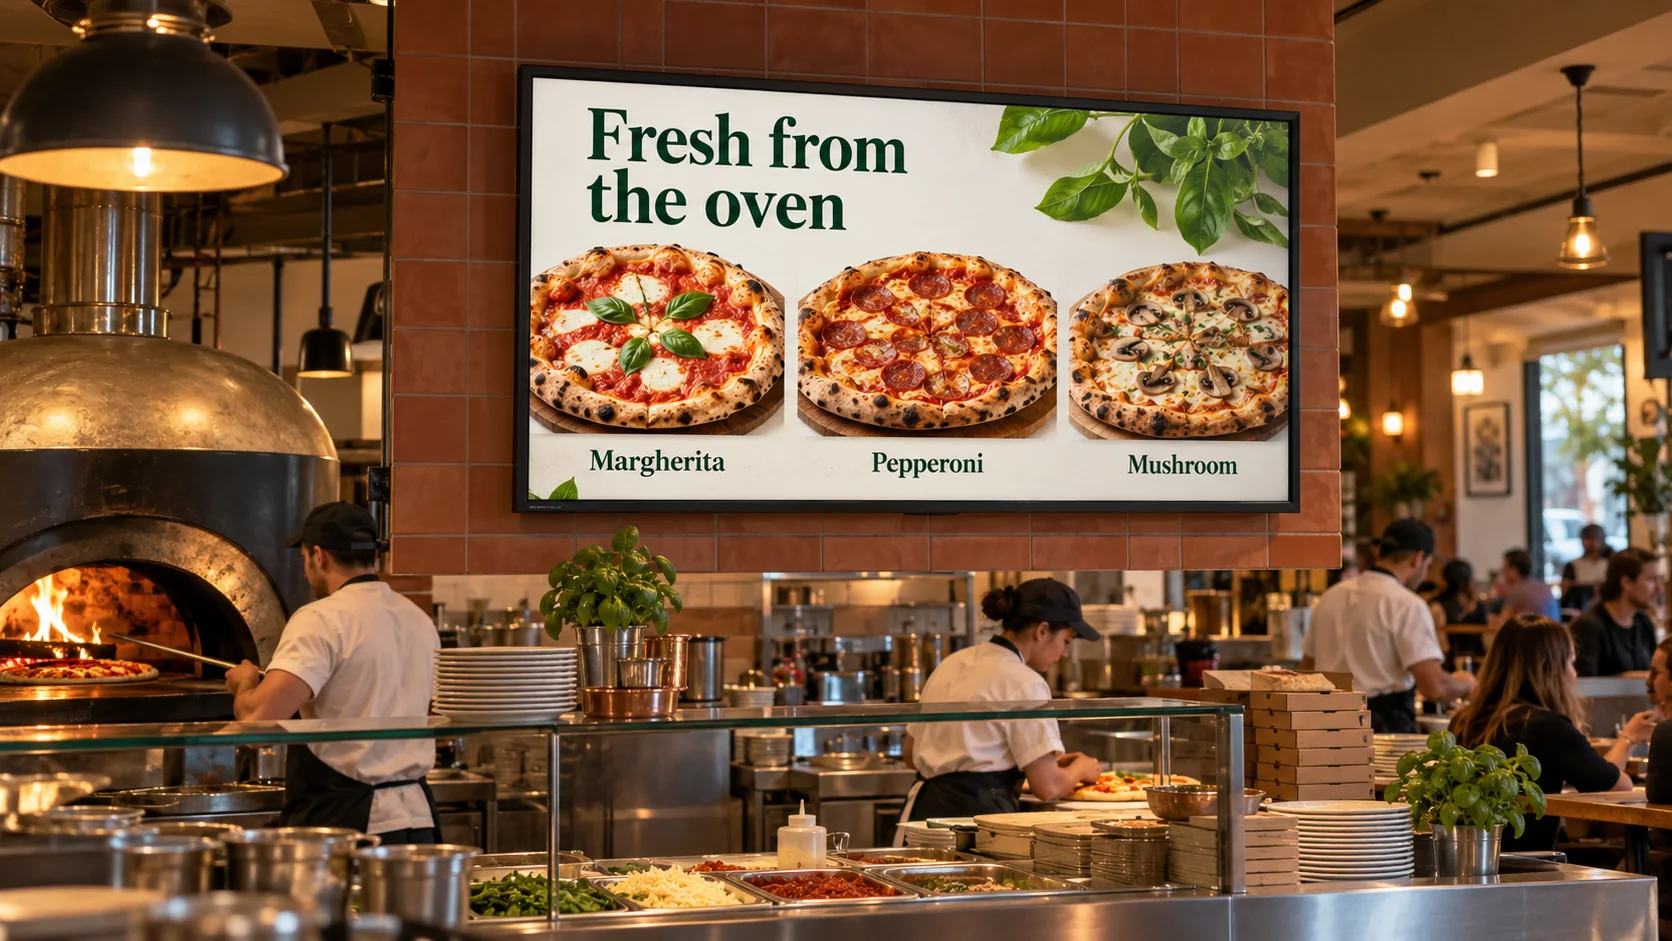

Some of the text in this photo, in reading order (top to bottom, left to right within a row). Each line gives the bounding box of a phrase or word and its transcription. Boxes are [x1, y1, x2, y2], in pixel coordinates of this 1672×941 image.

[588, 107, 908, 174] Fresh from
[587, 167, 847, 231] the oven
[589, 449, 726, 478] Margherita
[872, 451, 984, 479] Pepperoni
[1128, 453, 1238, 475] Mushroom
